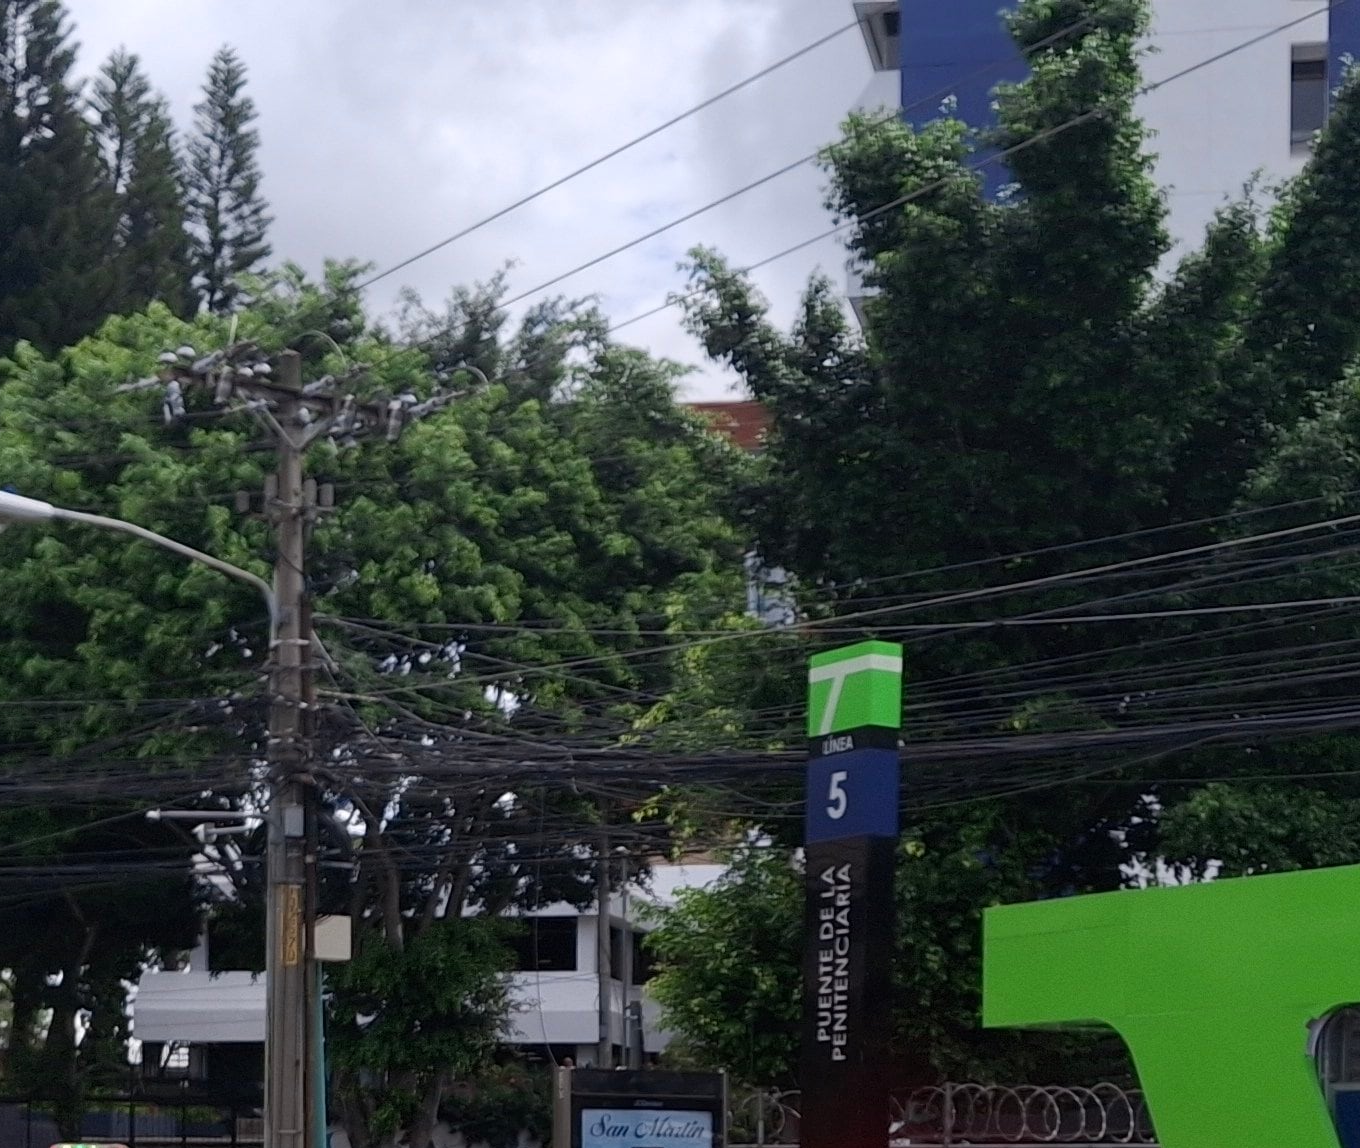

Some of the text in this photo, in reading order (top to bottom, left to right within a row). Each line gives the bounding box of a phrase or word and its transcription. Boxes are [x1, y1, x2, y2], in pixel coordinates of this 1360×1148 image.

[826, 771, 847, 820] 5
[817, 866, 836, 1041] PUENTE DE LA
[591, 1114, 630, 1138] San
